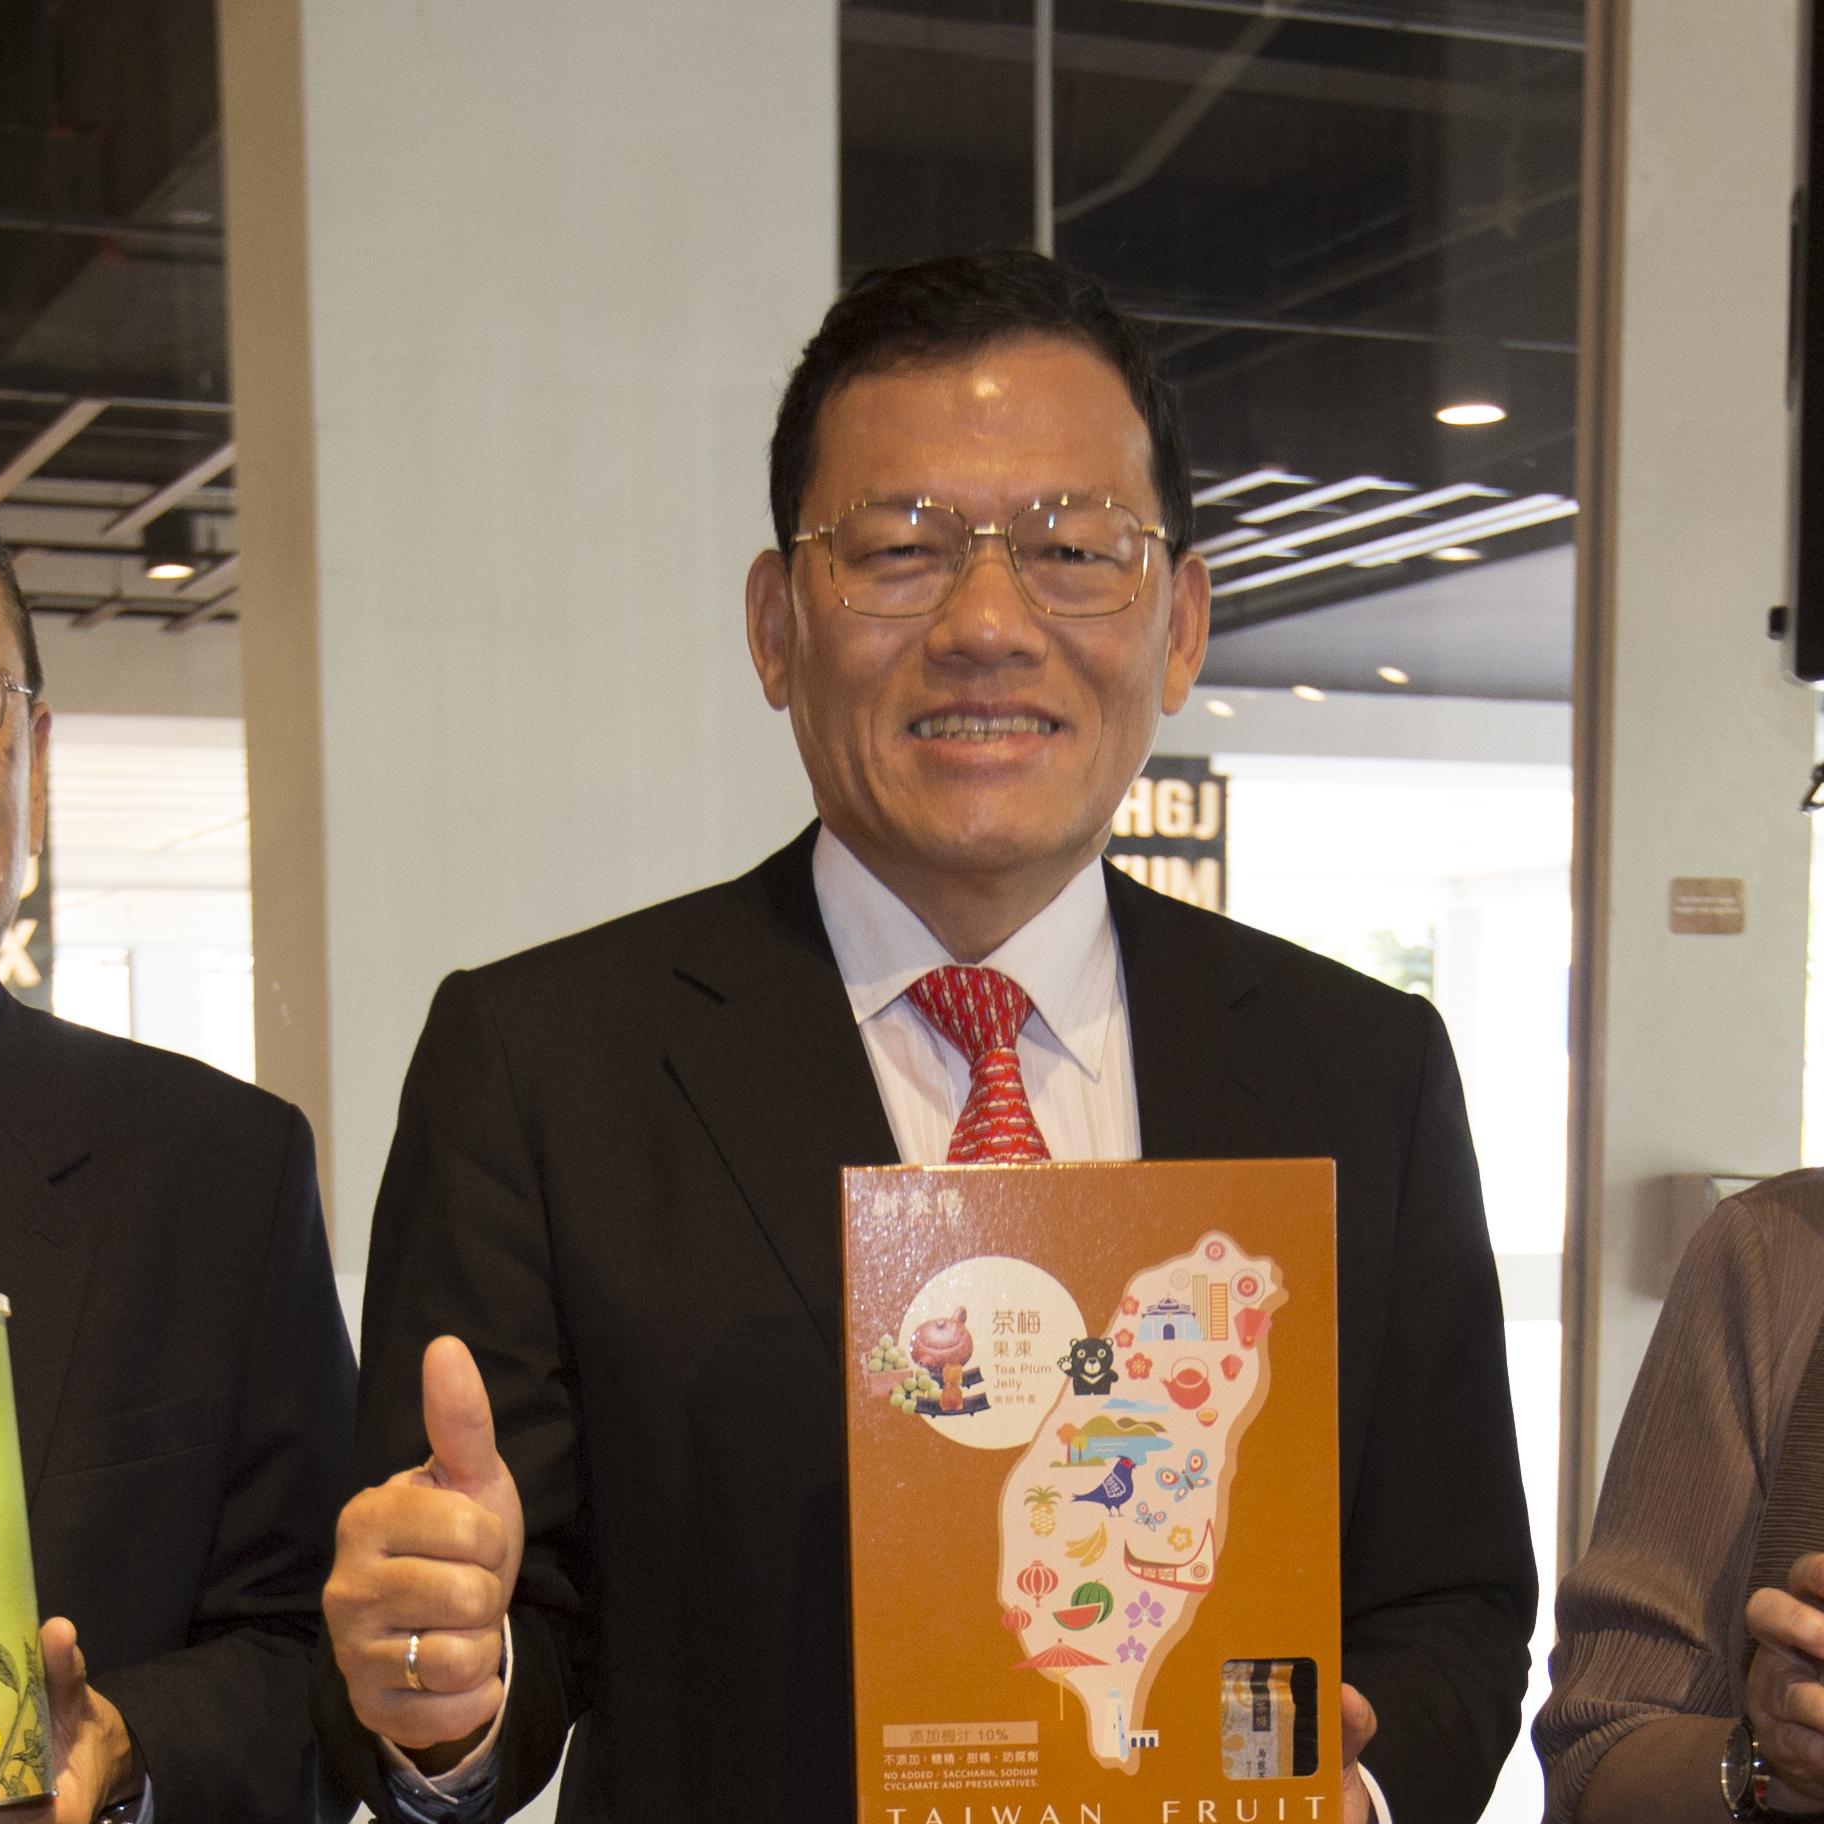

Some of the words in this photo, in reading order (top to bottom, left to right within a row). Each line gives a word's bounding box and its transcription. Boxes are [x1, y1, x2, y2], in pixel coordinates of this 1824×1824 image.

[992, 1309, 1041, 1336] 茶梅
[994, 1364, 1017, 1375] Tea
[1020, 1363, 1052, 1376] Plum
[994, 1379, 1023, 1391] Jelly
[978, 1729, 1009, 1741] 10%
[884, 1771, 898, 1780] NO
[1000, 1768, 1038, 1777] SODIUM
[884, 1782, 939, 1791] CYCLAMATE
[942, 1780, 963, 1789] AND
[1162, 1796, 1325, 1824] FRUIT
